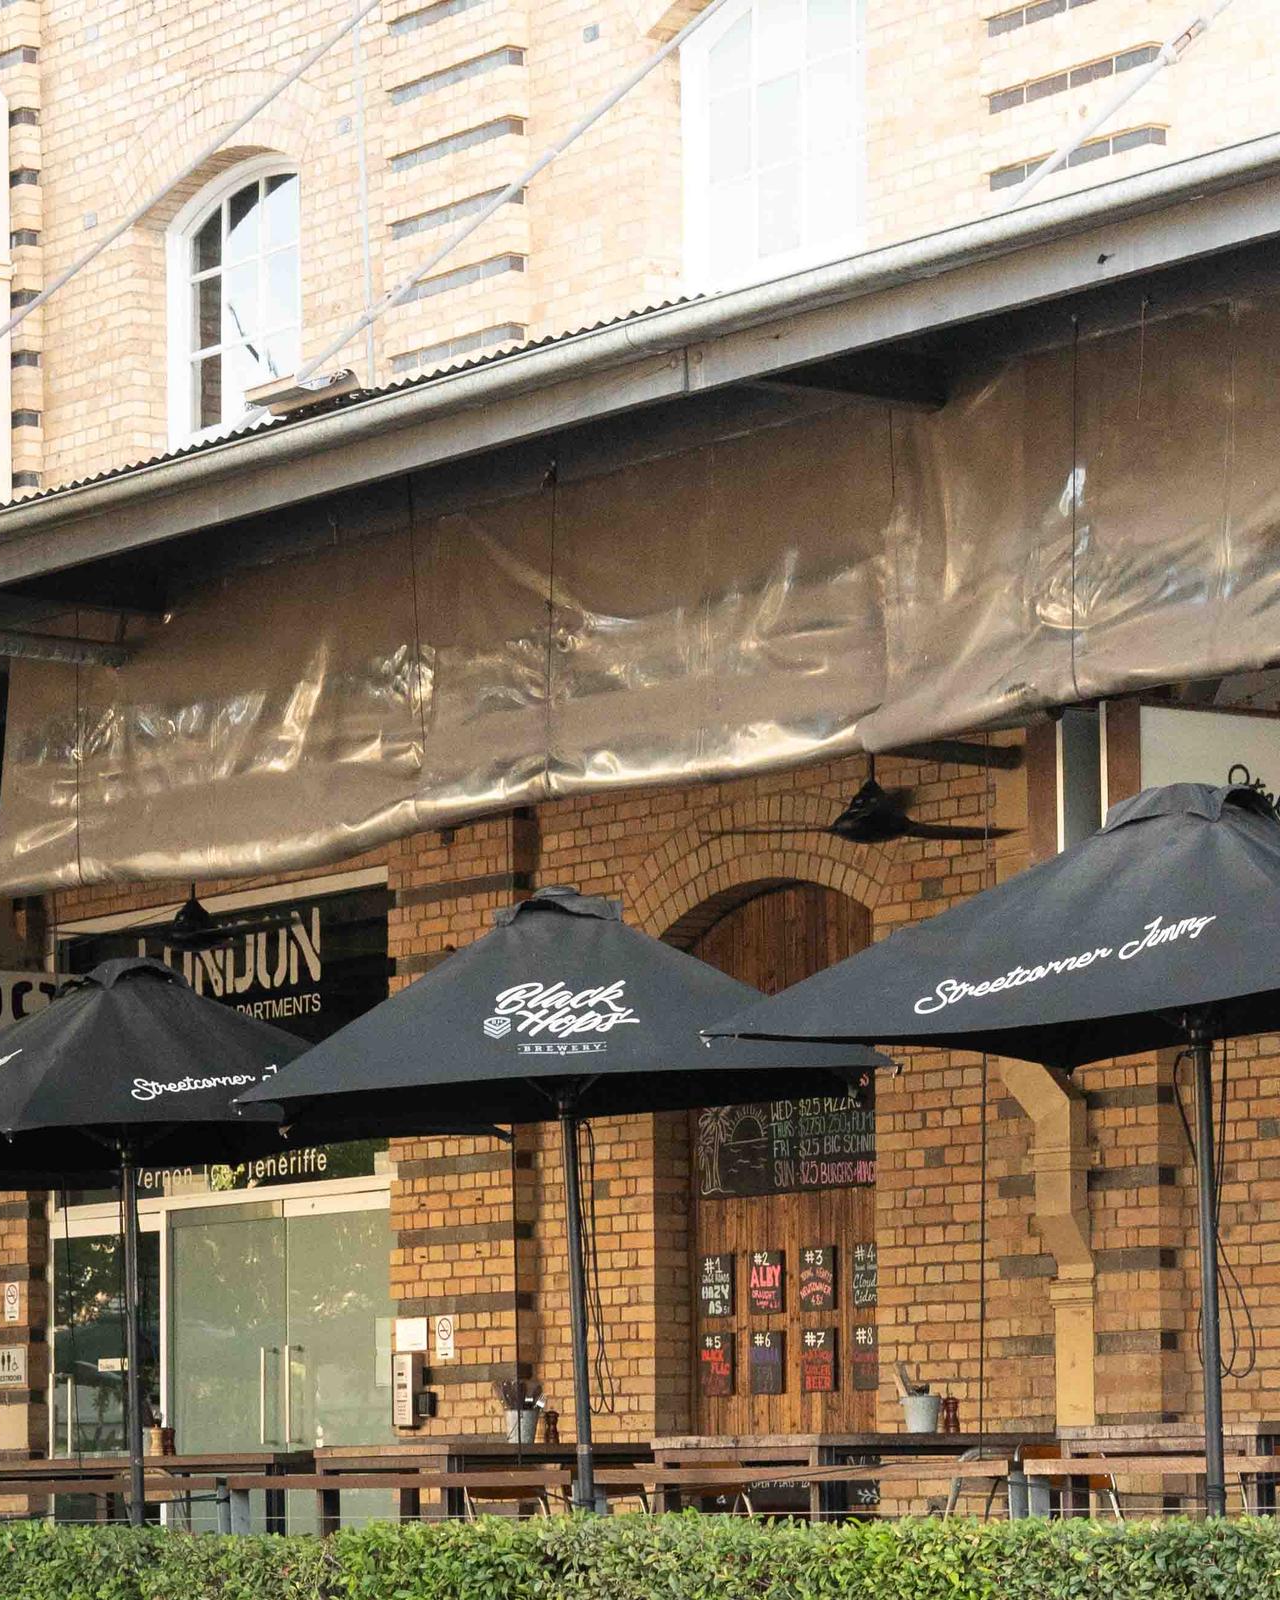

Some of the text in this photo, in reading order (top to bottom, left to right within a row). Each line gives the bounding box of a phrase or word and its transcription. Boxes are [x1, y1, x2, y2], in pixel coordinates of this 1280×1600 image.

[913, 914, 1218, 1015] Streetcorner Jimmy
[232, 992, 322, 1020] PARTMENTS
[494, 979, 627, 1015] Black
[514, 1006, 641, 1039] Hops
[523, 1042, 602, 1053] BREWERY
[130, 1072, 256, 1101] Streetcorner
[753, 1251, 770, 1266] #2
[804, 1249, 824, 1266] #3
[854, 1243, 876, 1262] #4
[704, 1257, 723, 1274] #1
[750, 1265, 781, 1288] ALBY
[852, 1272, 878, 1289] Cloud
[705, 1335, 722, 1349] #5
[754, 1332, 772, 1348] #6
[804, 1331, 826, 1349] #7
[855, 1326, 874, 1346] #8
